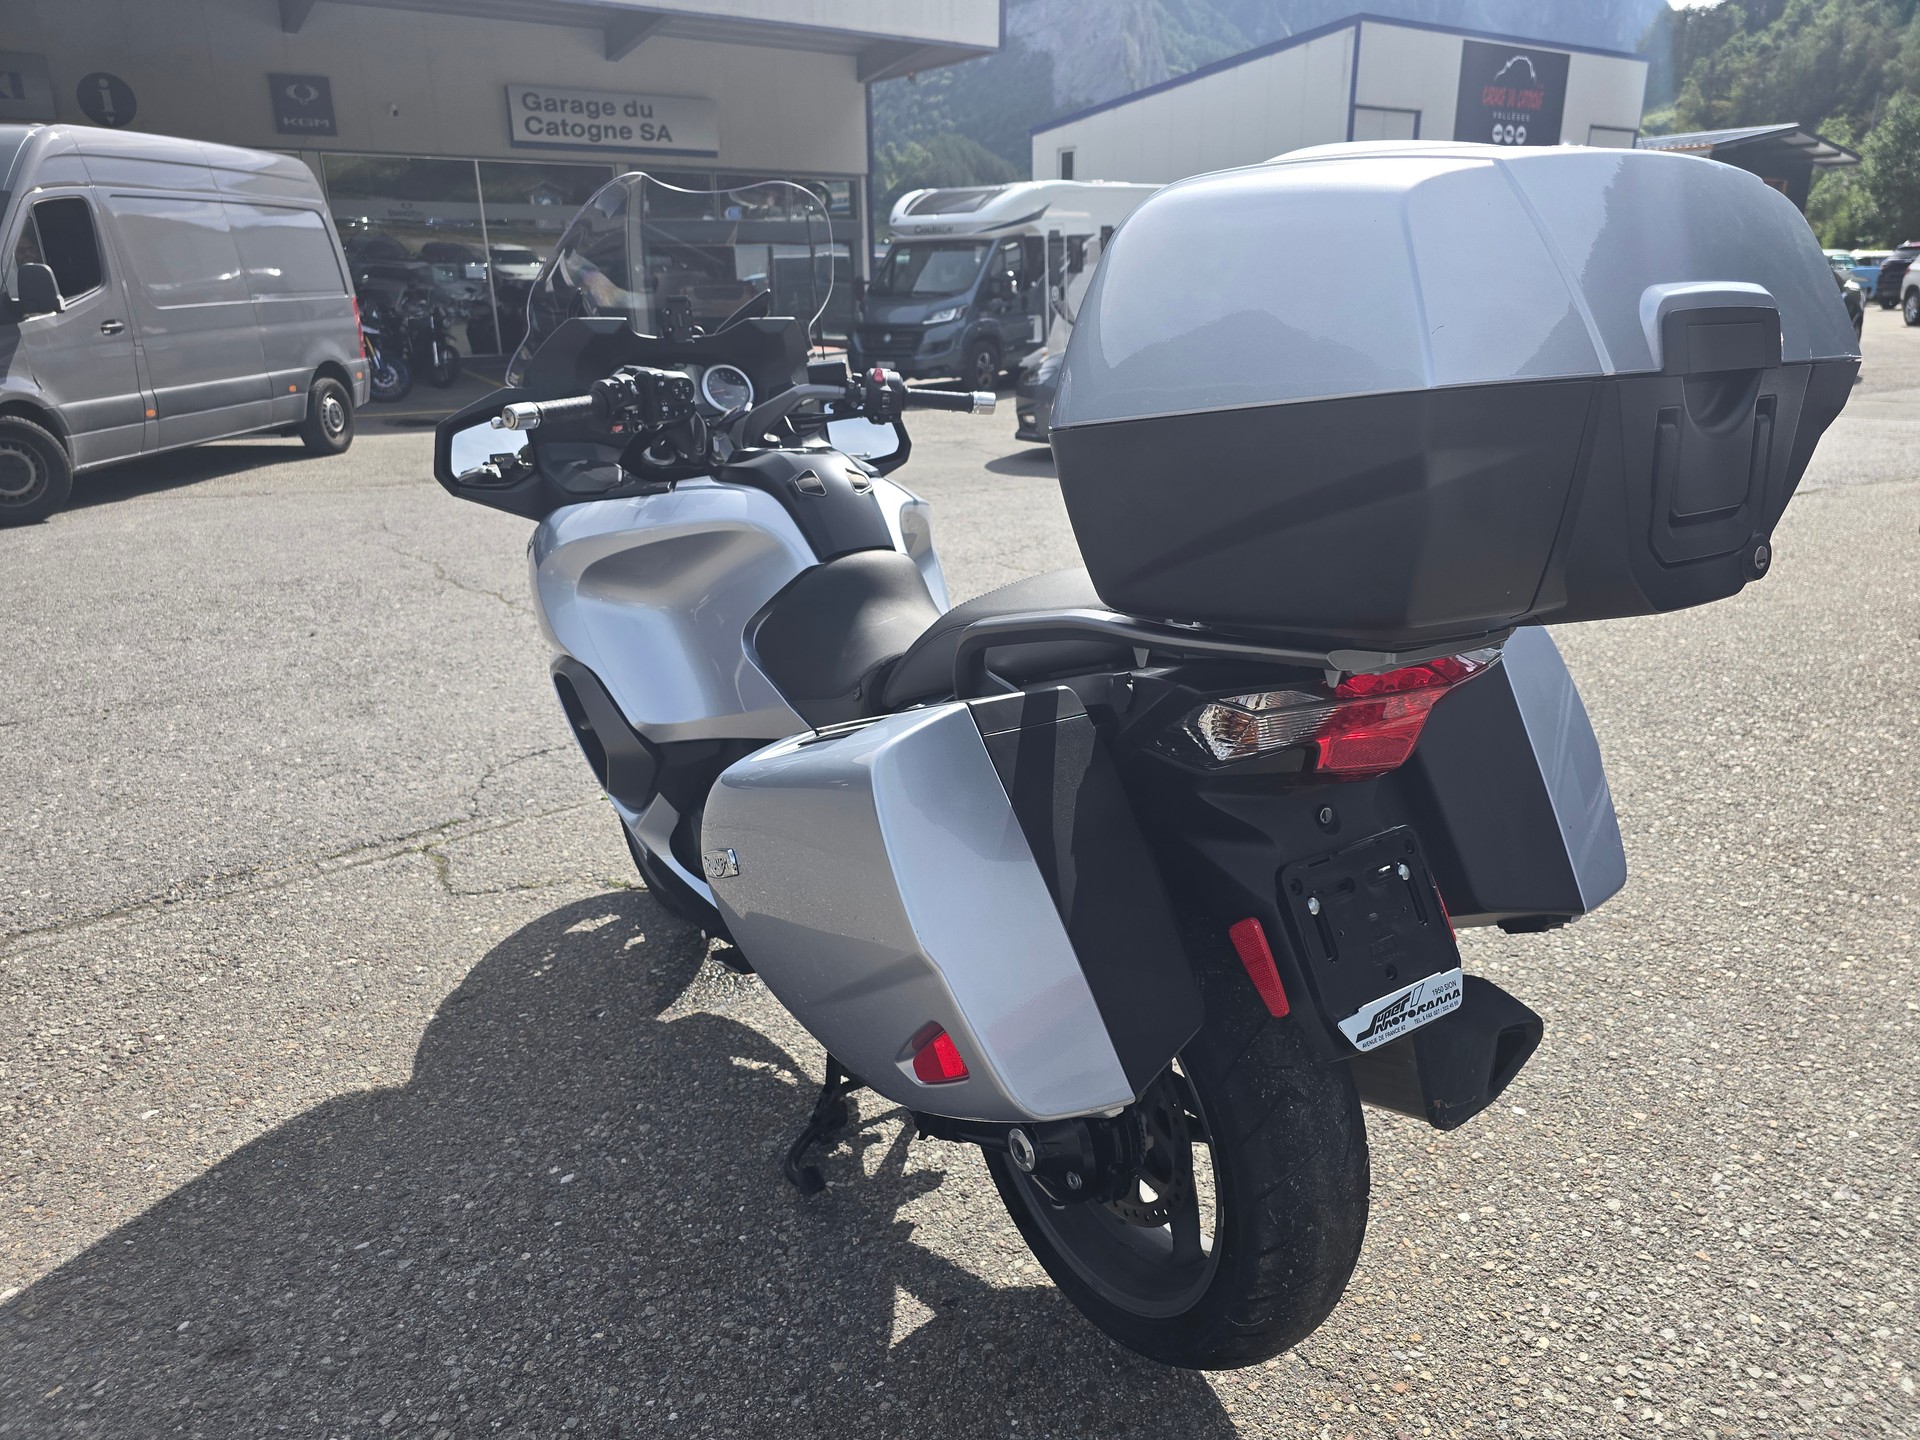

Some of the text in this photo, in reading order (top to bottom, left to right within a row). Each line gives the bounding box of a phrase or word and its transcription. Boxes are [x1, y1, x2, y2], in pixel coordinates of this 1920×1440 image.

[521, 92, 654, 119] Garage du
[283, 116, 330, 128] KGM
[524, 116, 673, 143] Catogne SA
[1432, 979, 1457, 996] 1950 SION
[1374, 988, 1460, 1034] MOTORAMA
[1362, 1038, 1378, 1049] AVENUE
[1384, 1028, 1401, 1039] FRANCE
